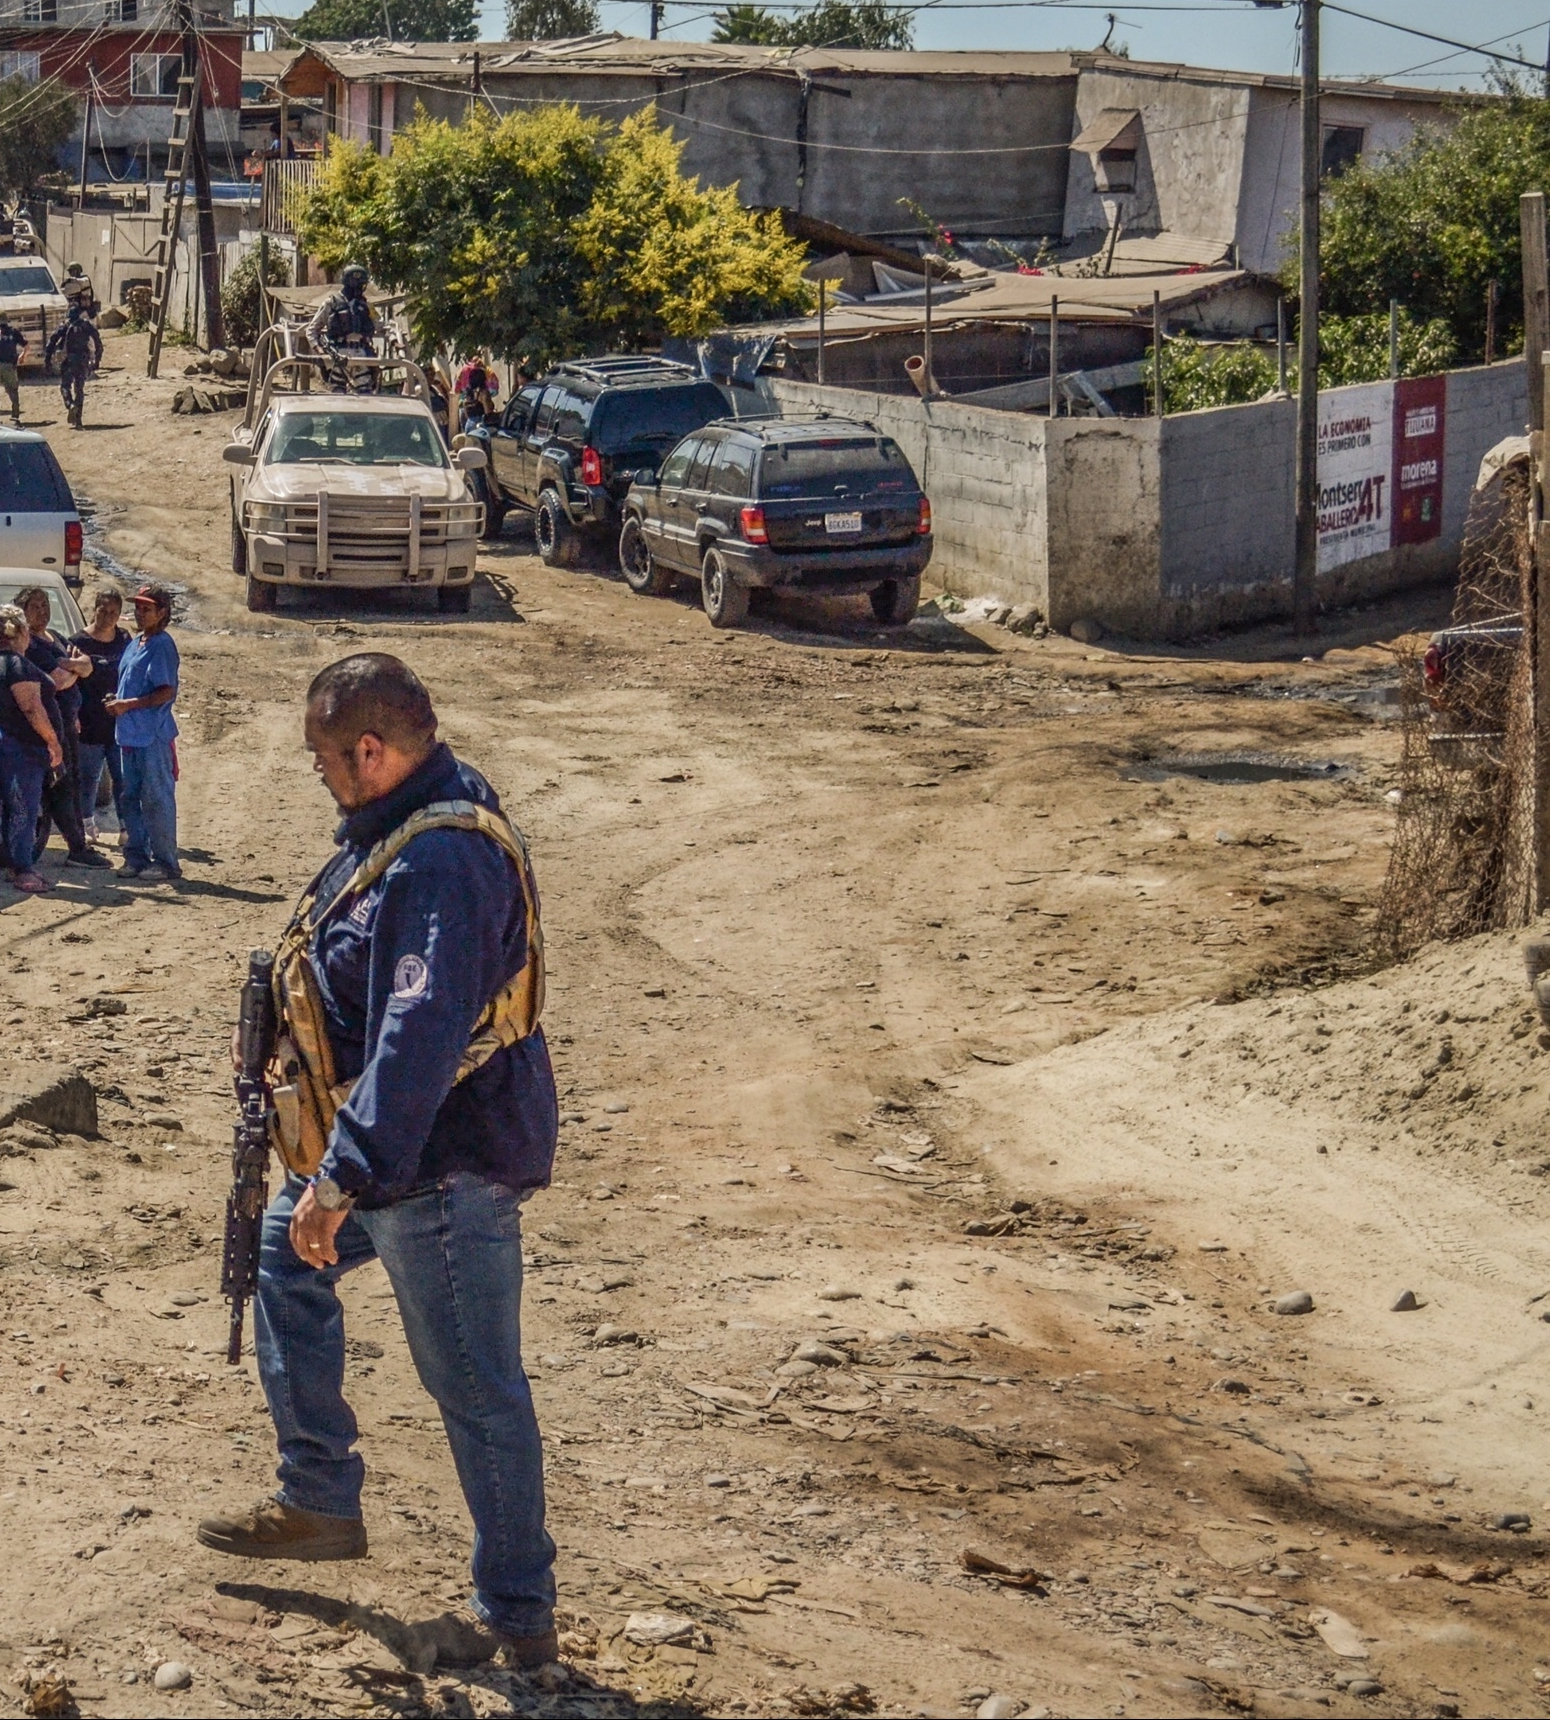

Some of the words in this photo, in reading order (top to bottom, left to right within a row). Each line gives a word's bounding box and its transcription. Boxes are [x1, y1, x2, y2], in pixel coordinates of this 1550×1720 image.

[1318, 423, 1328, 439] LA
[1318, 441, 1327, 455] ES
[1327, 437, 1356, 453] PRIMERO
[1357, 434, 1371, 448] CON
[1401, 460, 1437, 481] morena
[1316, 507, 1359, 533] ABALLERO
